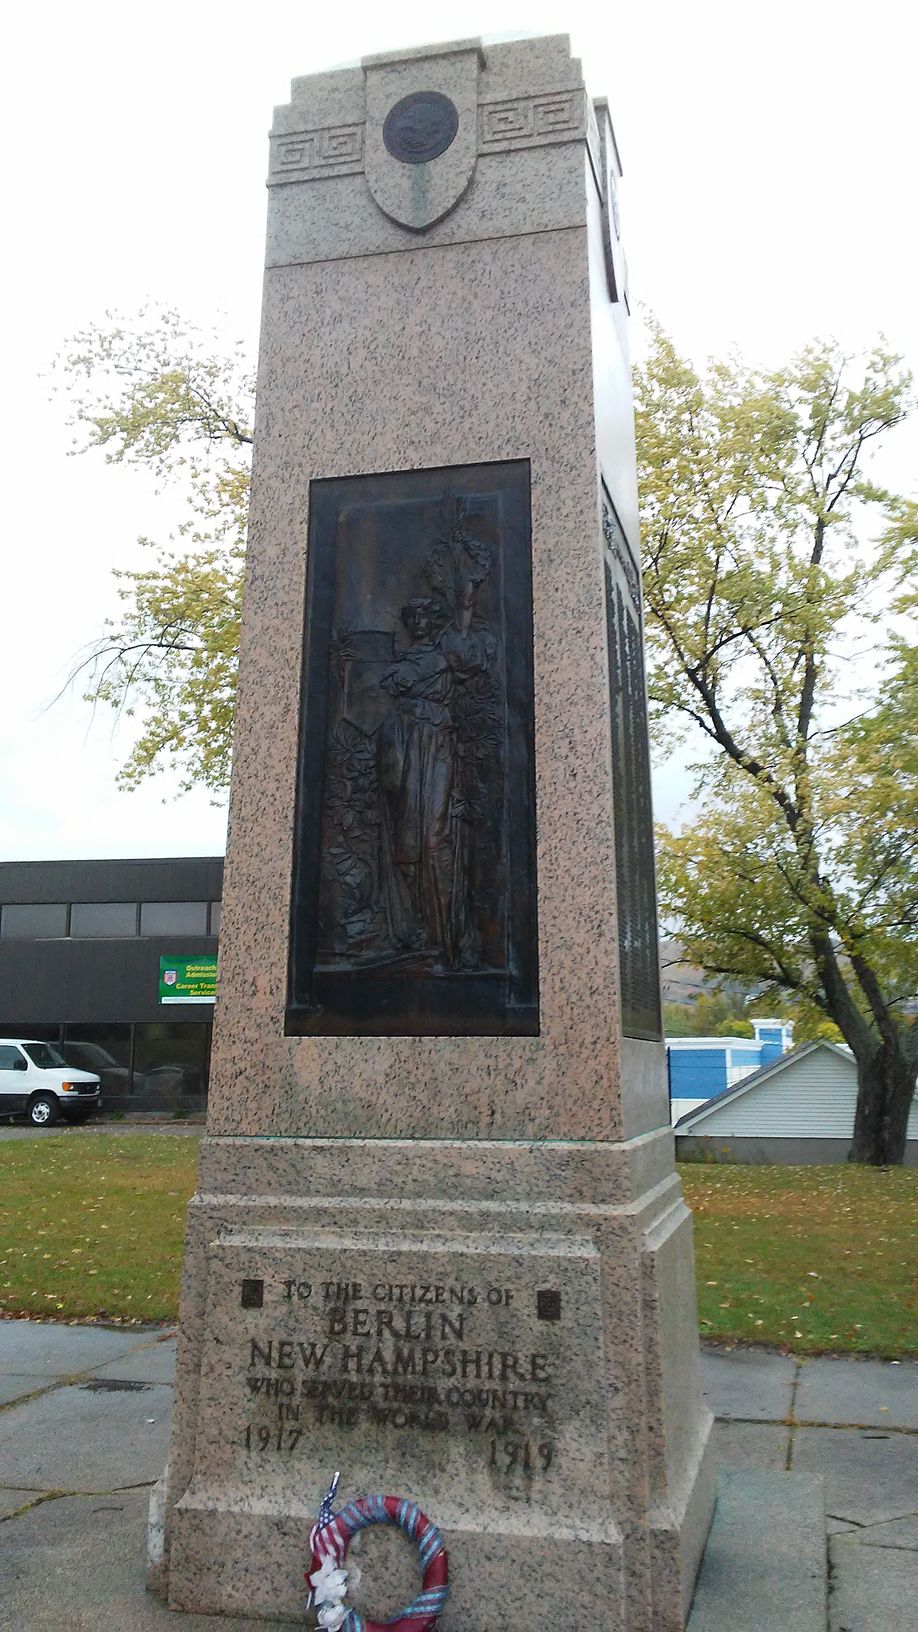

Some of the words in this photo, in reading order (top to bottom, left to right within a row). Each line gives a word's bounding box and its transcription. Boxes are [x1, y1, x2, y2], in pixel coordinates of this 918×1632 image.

[282, 1279, 312, 1299] TO
[321, 1281, 362, 1302] THE
[373, 1283, 478, 1304] CITIZENS
[486, 1288, 514, 1306] OF
[328, 1307, 465, 1341] BERLIN
[249, 1338, 331, 1369] NEW
[342, 1343, 552, 1382] HAMPSHIRE
[246, 1377, 293, 1396] WHO
[301, 1377, 373, 1402] SERVED
[381, 1383, 442, 1405] THEIR
[445, 1387, 553, 1410] COUNTRY
[279, 1404, 299, 1421] IN
[315, 1403, 360, 1425] THE
[371, 1408, 449, 1431] WORLD
[465, 1414, 517, 1433] WAR
[243, 1423, 303, 1451] 1917
[489, 1438, 553, 1471] 1919
